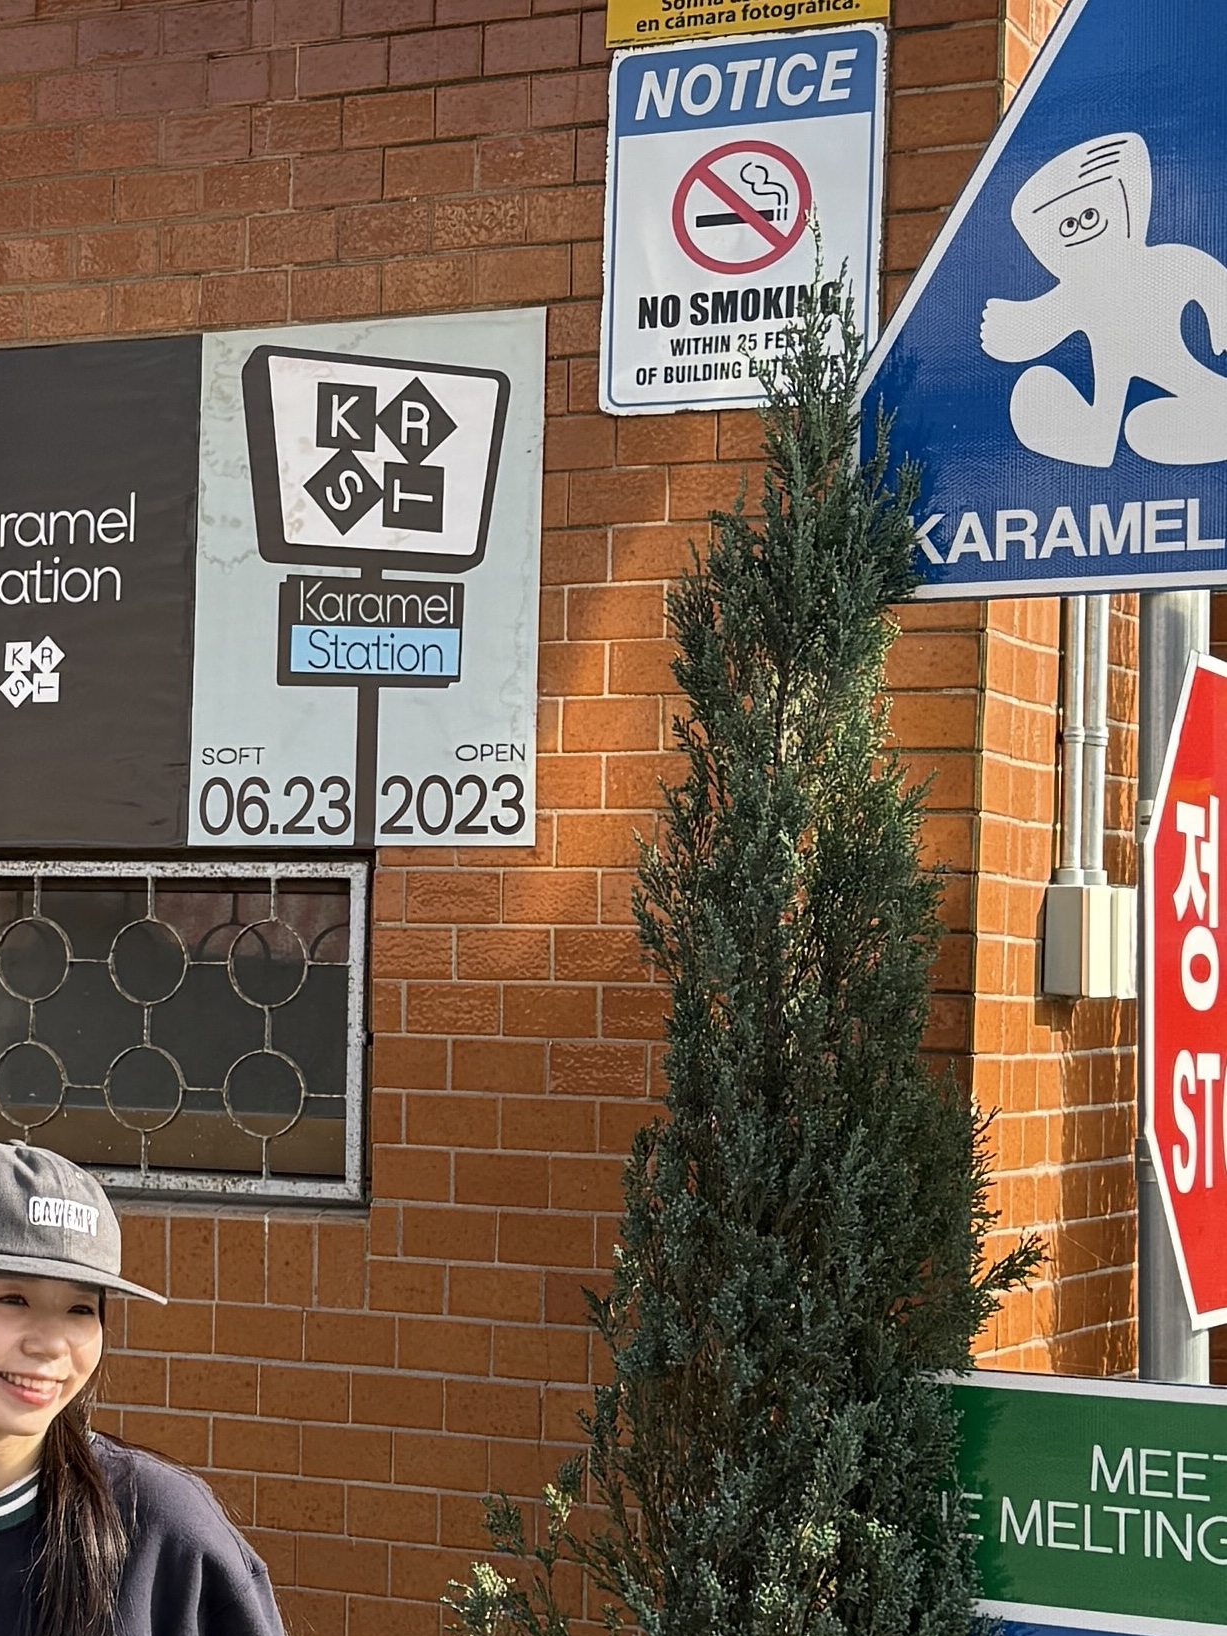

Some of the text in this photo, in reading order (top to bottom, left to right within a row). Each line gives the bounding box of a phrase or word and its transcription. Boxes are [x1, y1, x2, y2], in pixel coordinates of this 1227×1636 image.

[636, 20, 659, 32] en
[665, 11, 736, 30] cámara
[635, 48, 858, 121] NOTICE
[638, 294, 681, 330] NO
[670, 335, 731, 357] WITHIN
[737, 333, 758, 352] 25
[636, 367, 657, 386] OF
[663, 361, 742, 384] BUILDING
[907, 498, 1226, 565] KARAMEL
[299, 580, 454, 624] Karamel
[307, 629, 443, 673] Station
[201, 743, 526, 765] SOFT OPEN
[199, 774, 526, 837] 06.23 2023
[1172, 794, 1220, 1012] 정
[1172, 1049, 1227, 1195] ST
[1000, 1496, 1227, 1566] MELTING
